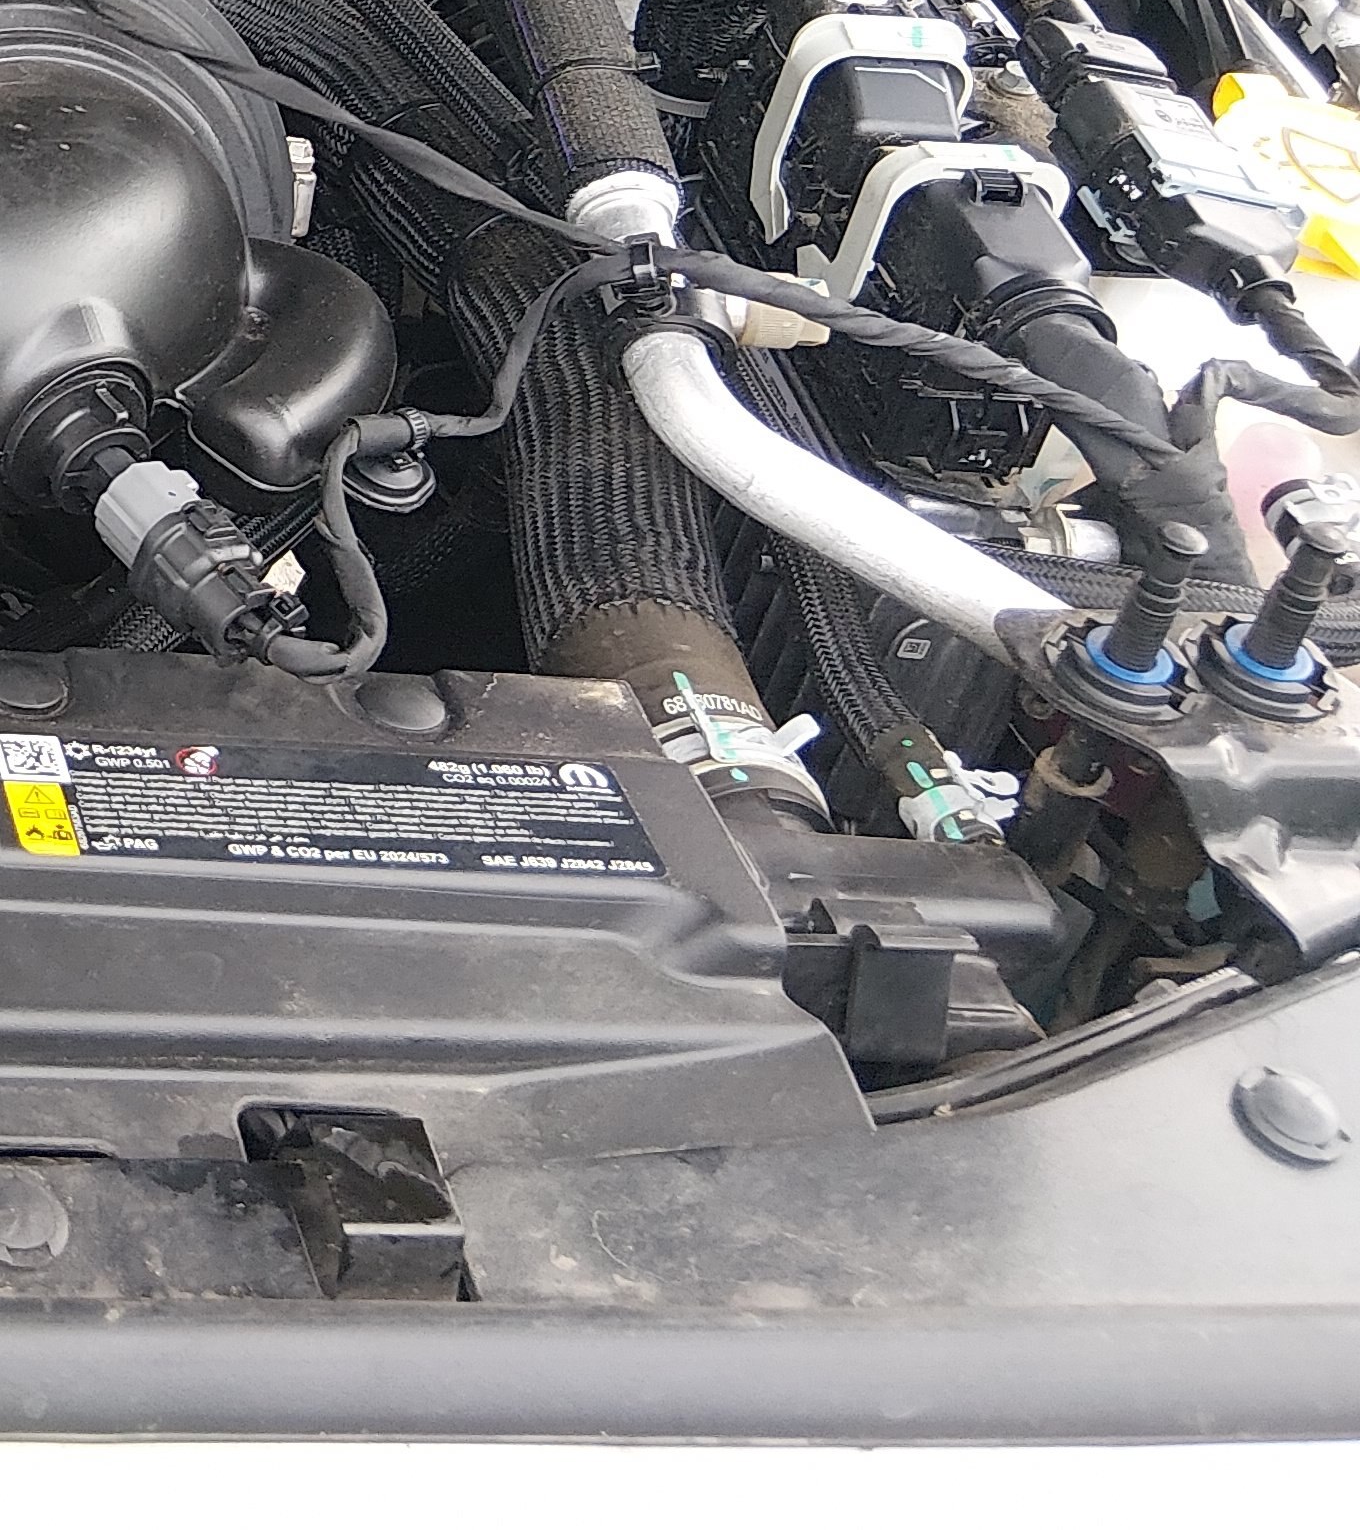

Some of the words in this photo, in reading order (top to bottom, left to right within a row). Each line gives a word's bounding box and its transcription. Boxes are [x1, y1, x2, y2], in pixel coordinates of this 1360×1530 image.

[94, 756, 131, 768] GWP
[123, 836, 159, 851] PAG
[351, 849, 377, 861] EU
[480, 854, 518, 868] SAE
